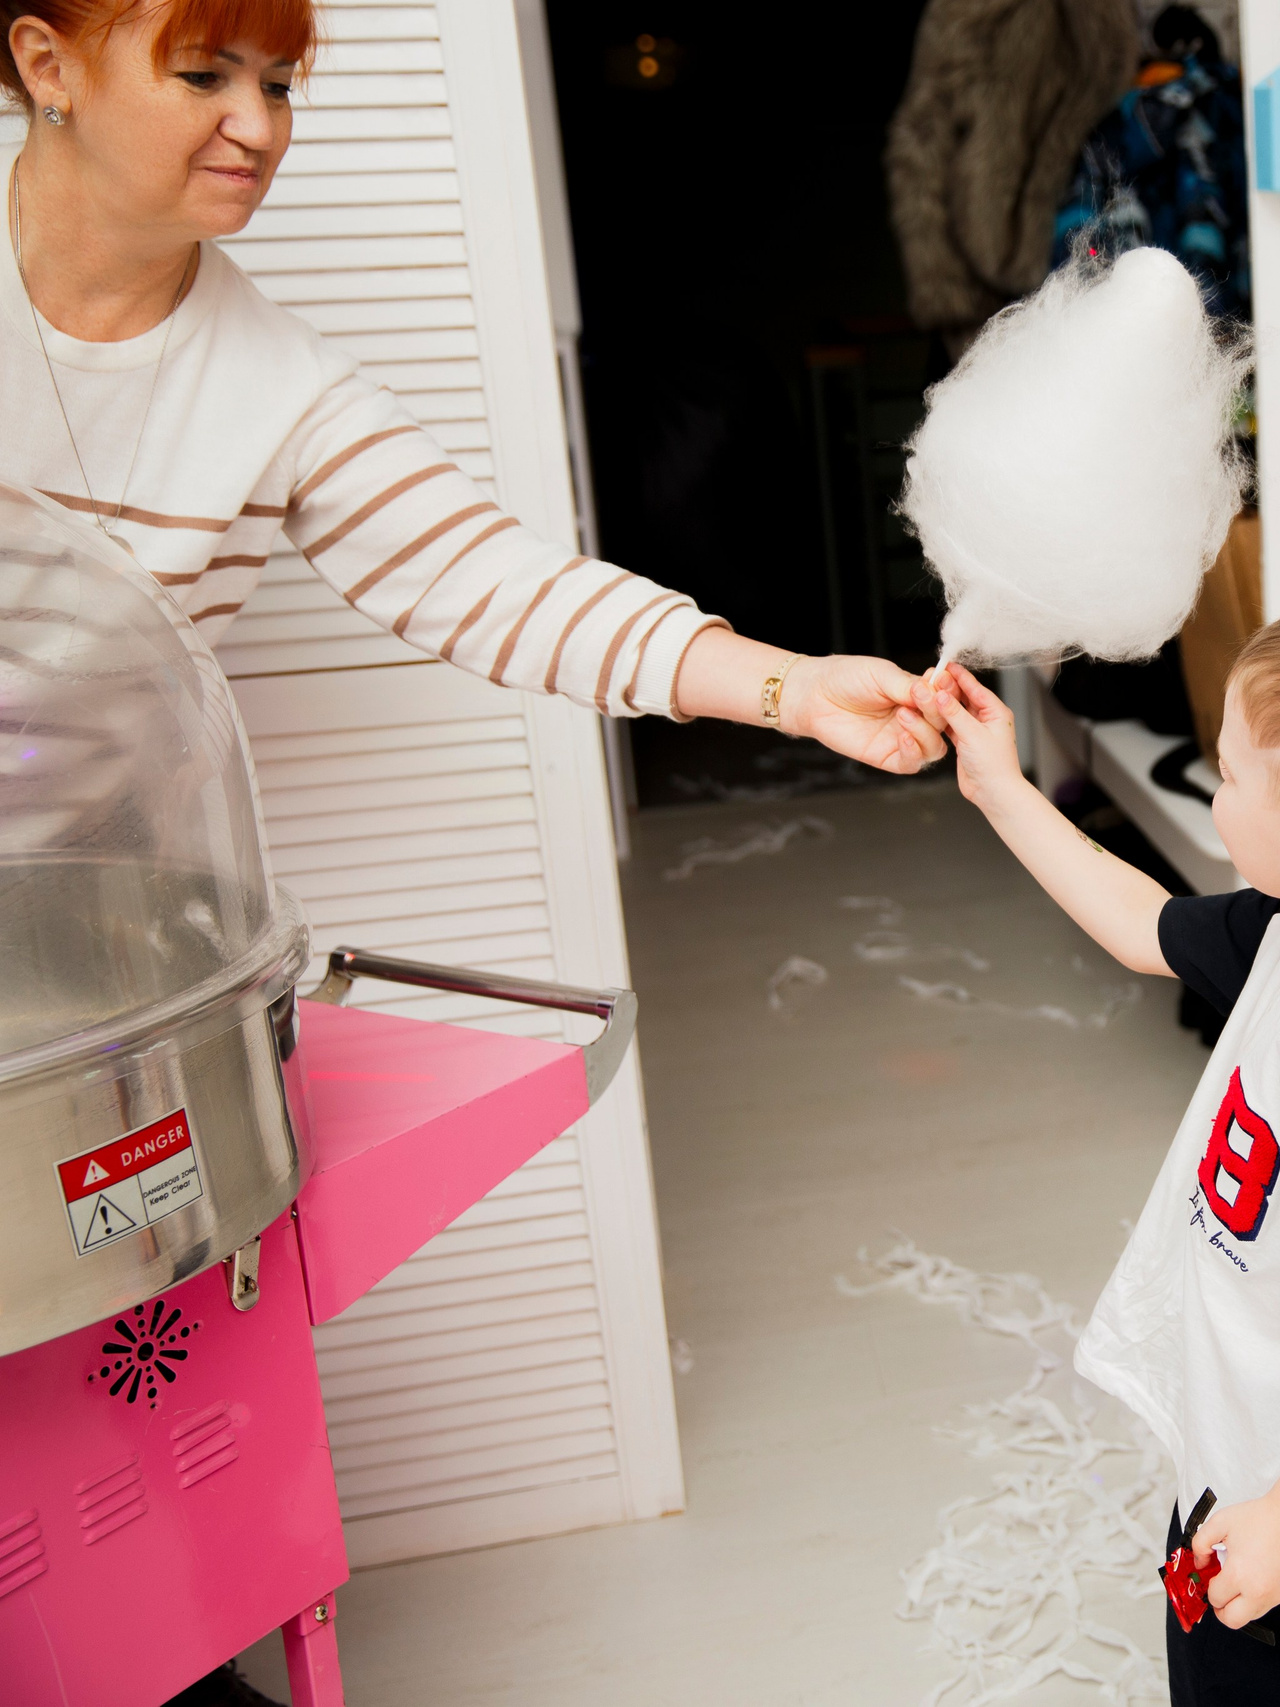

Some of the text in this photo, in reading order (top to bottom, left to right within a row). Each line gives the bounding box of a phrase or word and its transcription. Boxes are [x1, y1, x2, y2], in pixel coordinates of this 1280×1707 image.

[120, 1125, 185, 1167] DANGER
[142, 1165, 196, 1198] DANGEROUS ZONE
[149, 1180, 191, 1206] Keep Clear
[1208, 1231, 1249, 1272] brave
